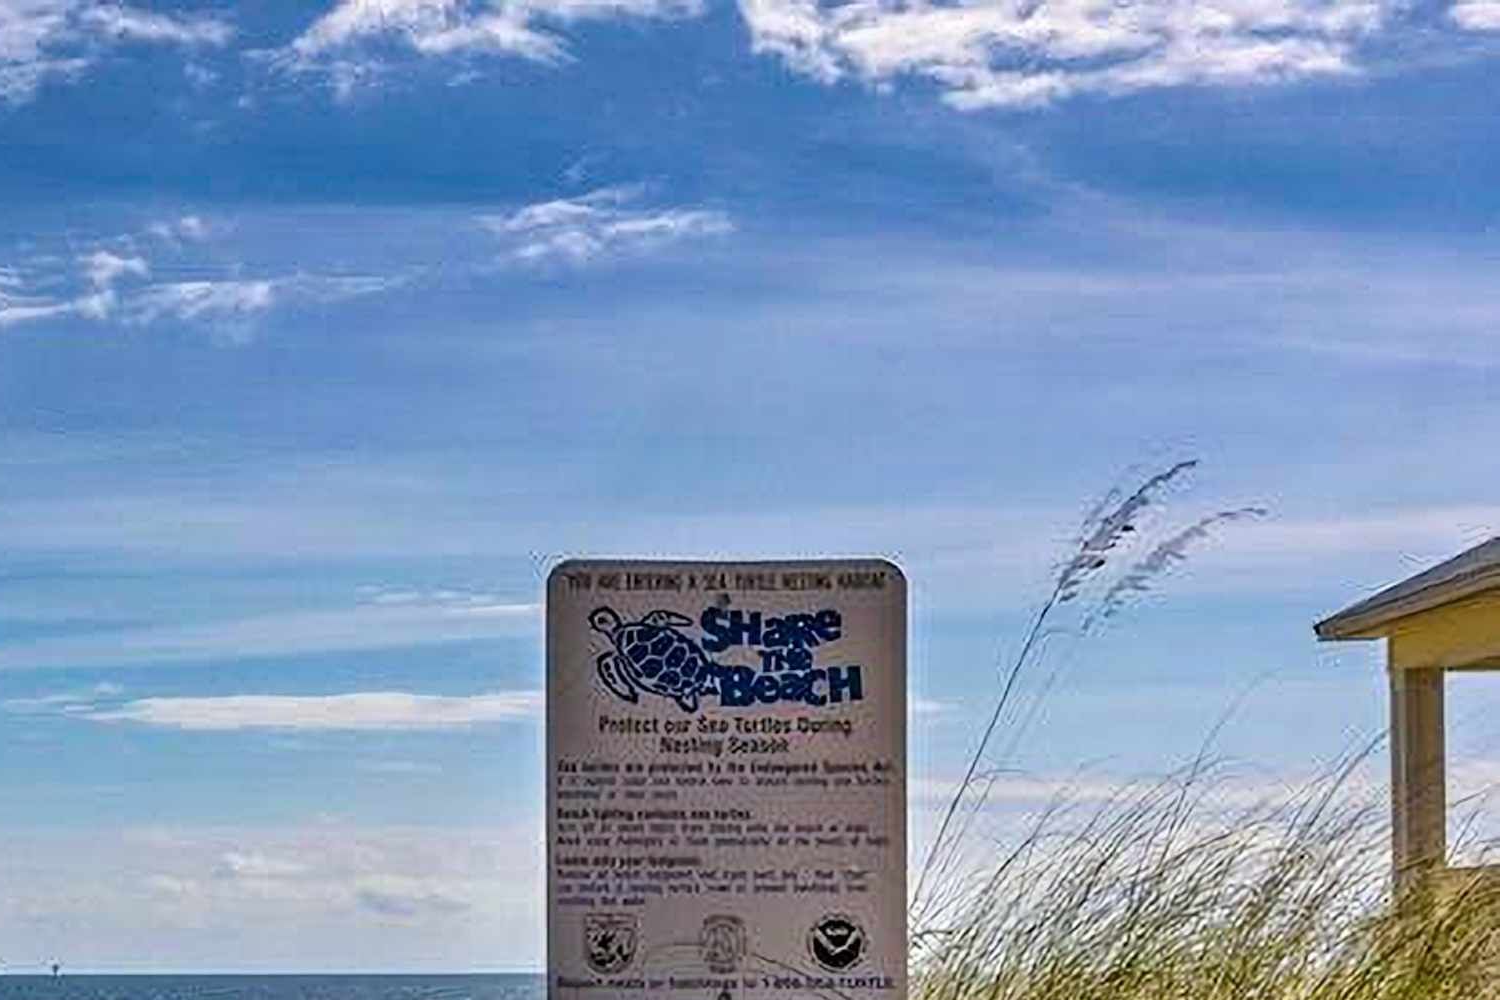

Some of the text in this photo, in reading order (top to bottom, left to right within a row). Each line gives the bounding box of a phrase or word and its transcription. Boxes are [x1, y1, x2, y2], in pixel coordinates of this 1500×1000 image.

[599, 715, 658, 734] Protect
[697, 715, 729, 734] Sea
[734, 716, 791, 734] Turtles
[659, 736, 790, 757] Nesting Season
